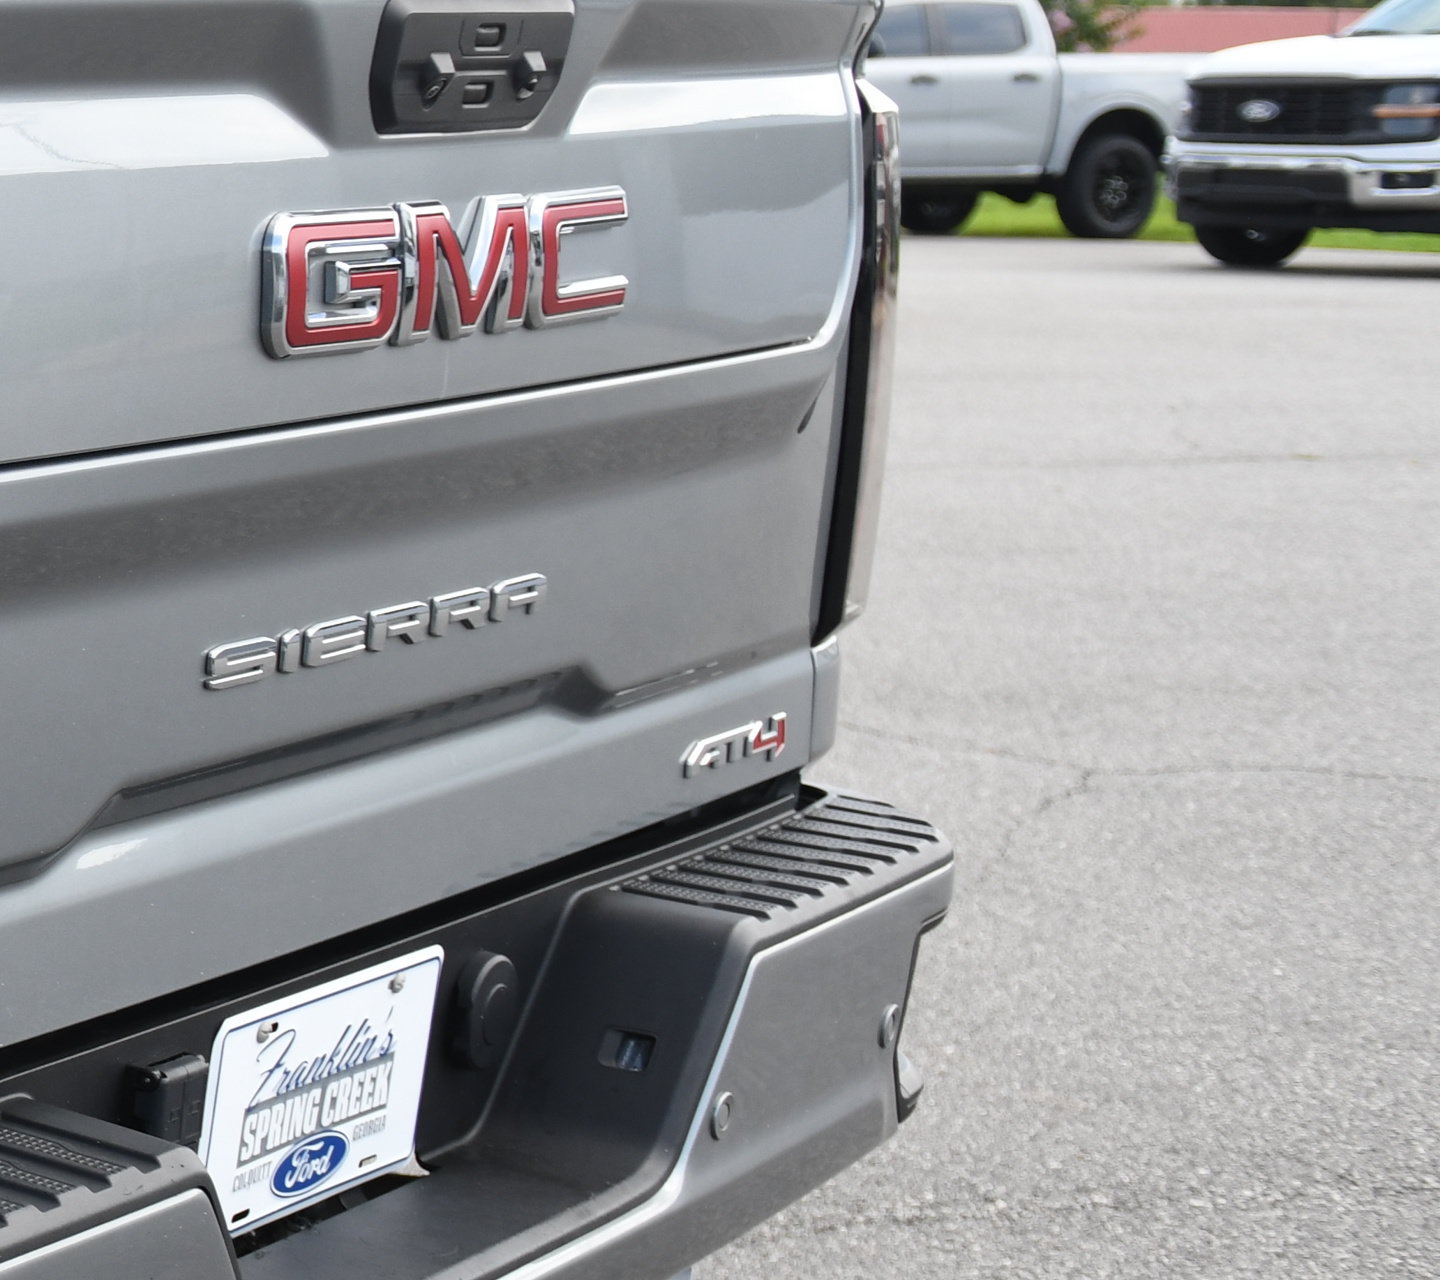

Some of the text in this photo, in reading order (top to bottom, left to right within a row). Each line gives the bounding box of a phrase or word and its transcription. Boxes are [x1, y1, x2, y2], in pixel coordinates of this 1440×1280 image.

[261, 184, 630, 360] GMC
[201, 572, 547, 692] SIERRA
[238, 1061, 394, 1163] SPRING CREEK
[246, 1005, 400, 1112] Franklin's
[284, 1140, 335, 1189] Ford
